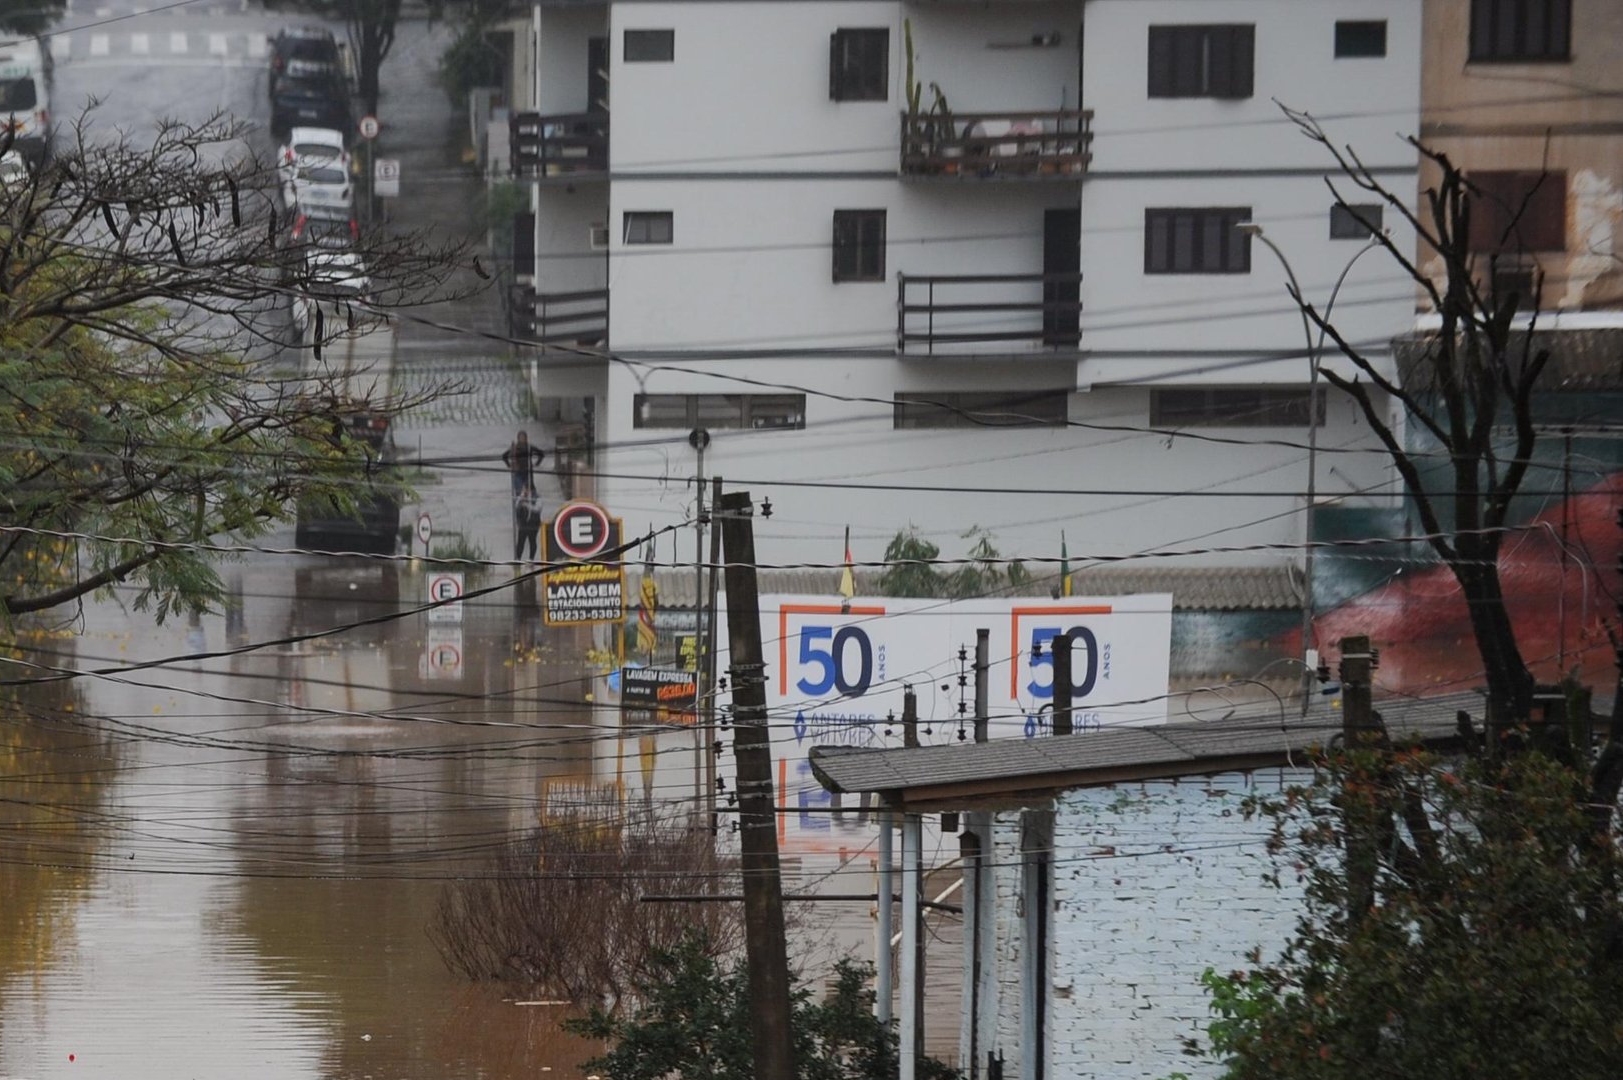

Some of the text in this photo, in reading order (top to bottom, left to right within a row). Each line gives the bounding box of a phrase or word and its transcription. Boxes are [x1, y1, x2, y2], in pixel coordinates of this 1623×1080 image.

[570, 516, 593, 544] E
[440, 583, 452, 599] E
[547, 583, 621, 599] LAVAGEM
[548, 598, 621, 610] ESTACIONAMENTO
[796, 625, 873, 698] 50
[1103, 643, 1111, 680] ANOS
[626, 670, 658, 681] LAVAGEM
